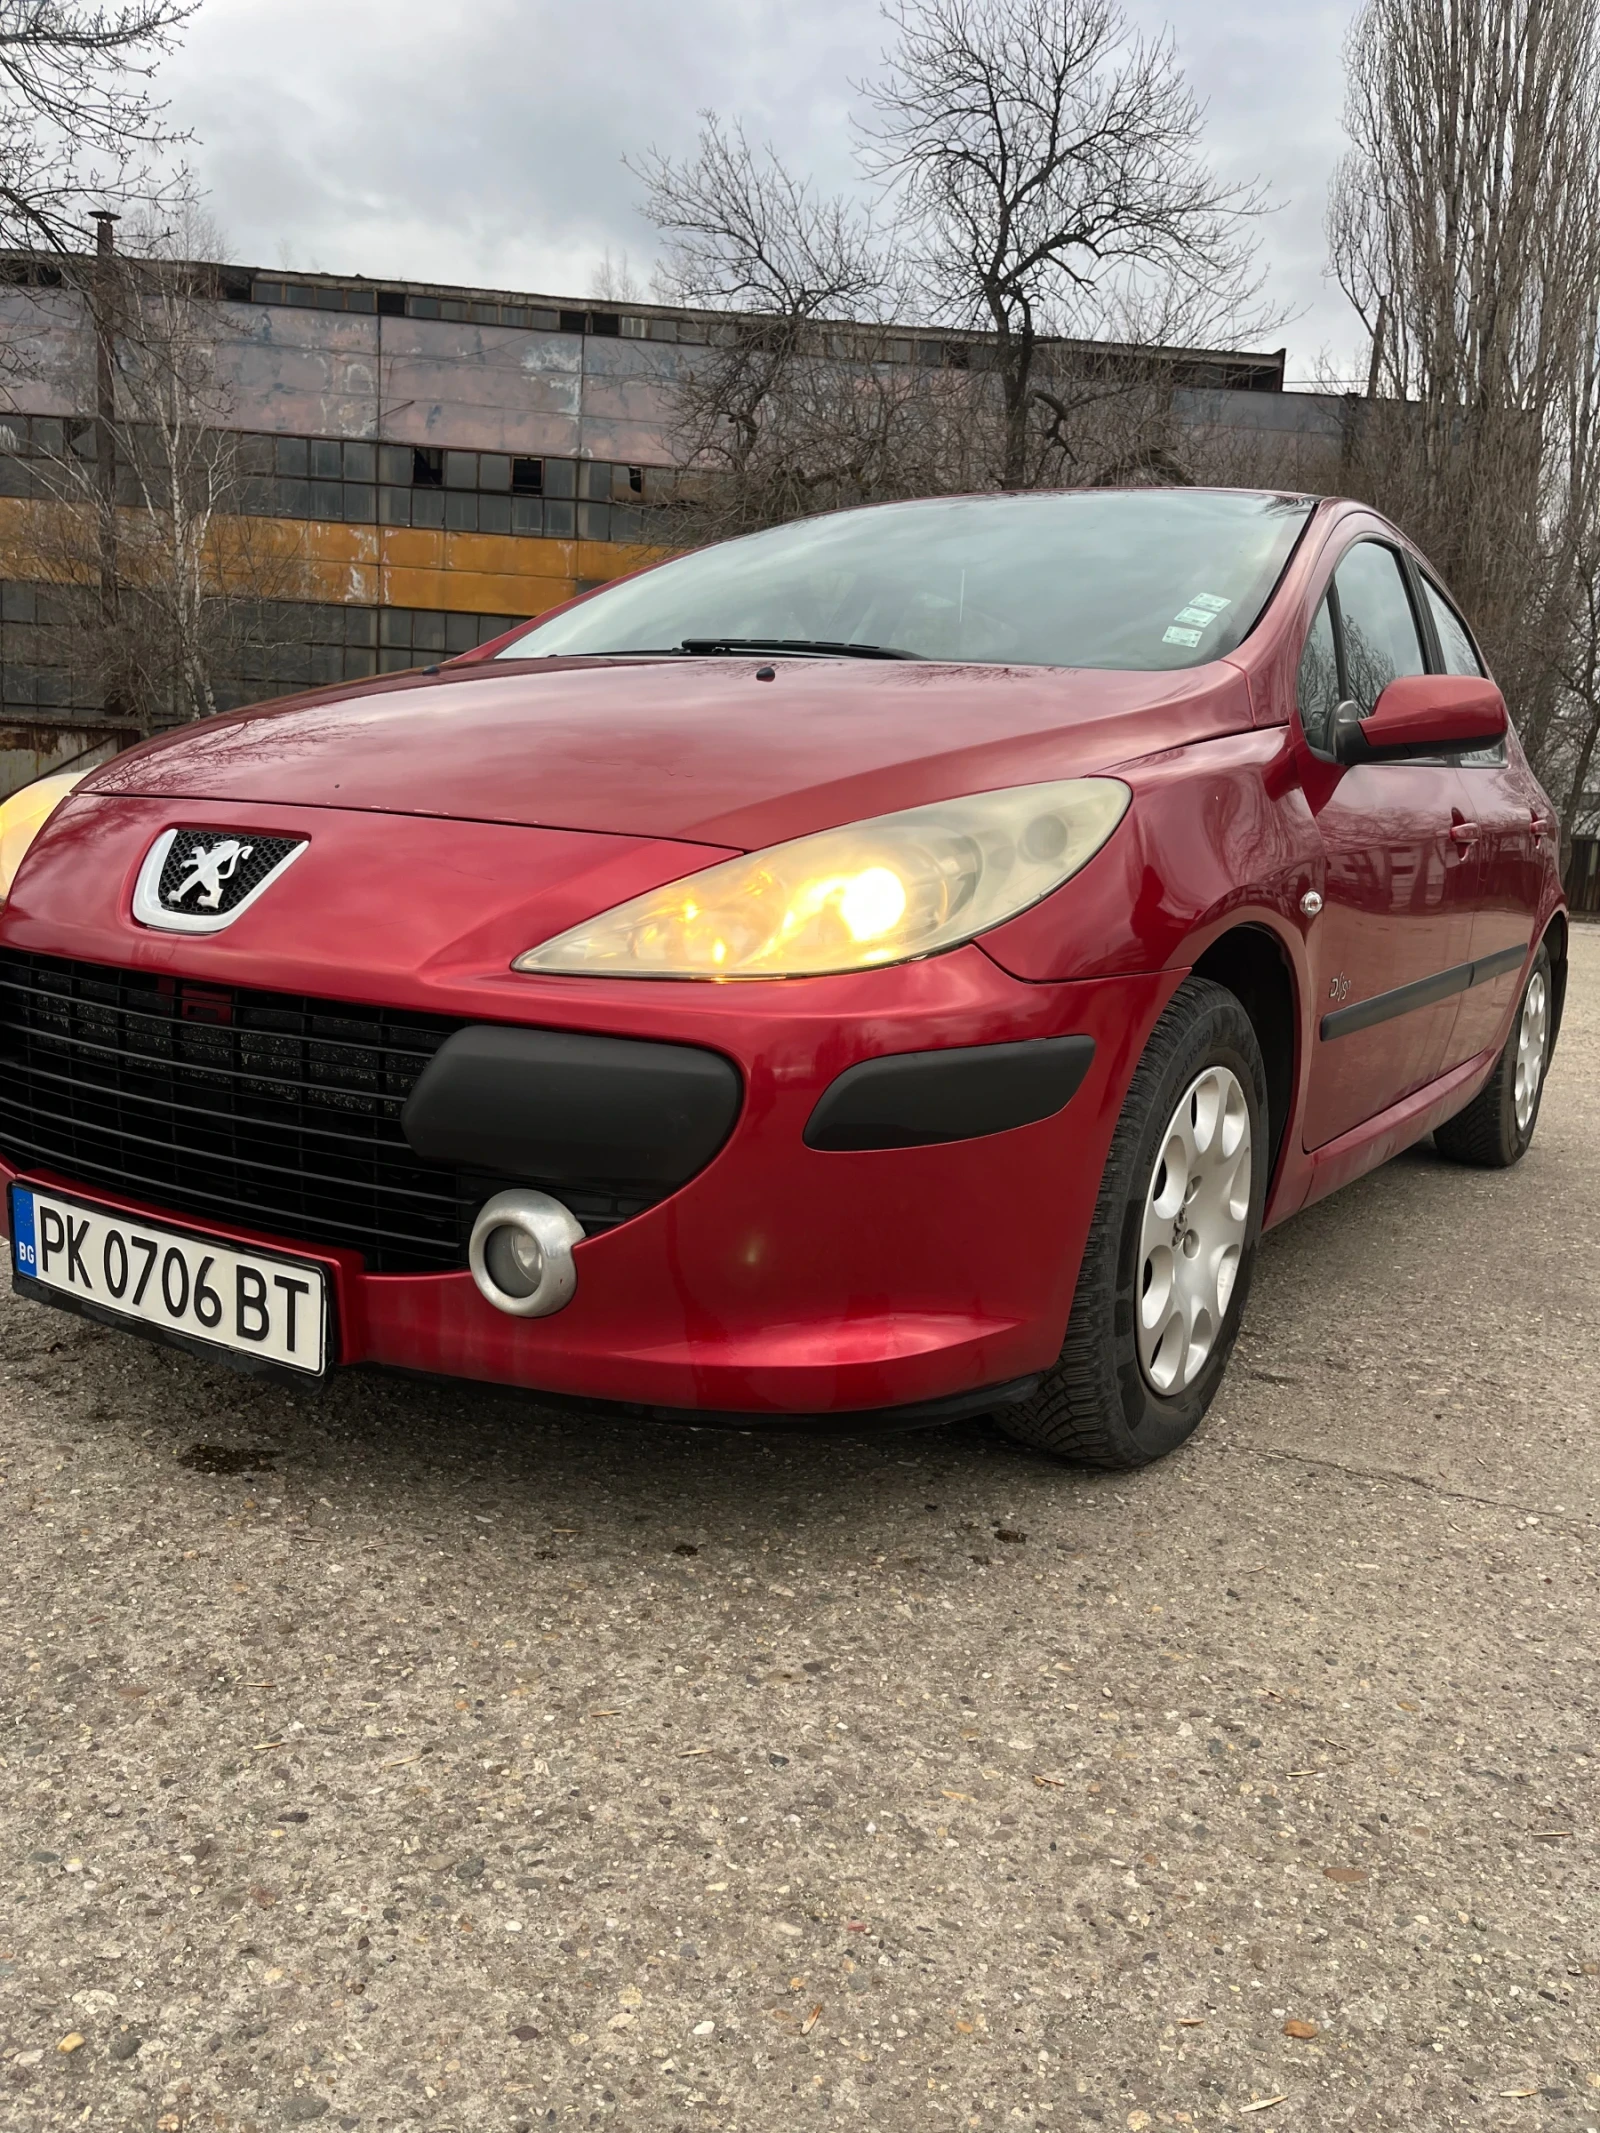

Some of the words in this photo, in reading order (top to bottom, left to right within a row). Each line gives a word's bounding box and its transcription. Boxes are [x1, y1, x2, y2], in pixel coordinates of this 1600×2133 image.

[18, 1240, 35, 1265] BG
[39, 1205, 93, 1289] PK
[103, 1229, 223, 1328] 0706
[235, 1264, 310, 1353] BT
